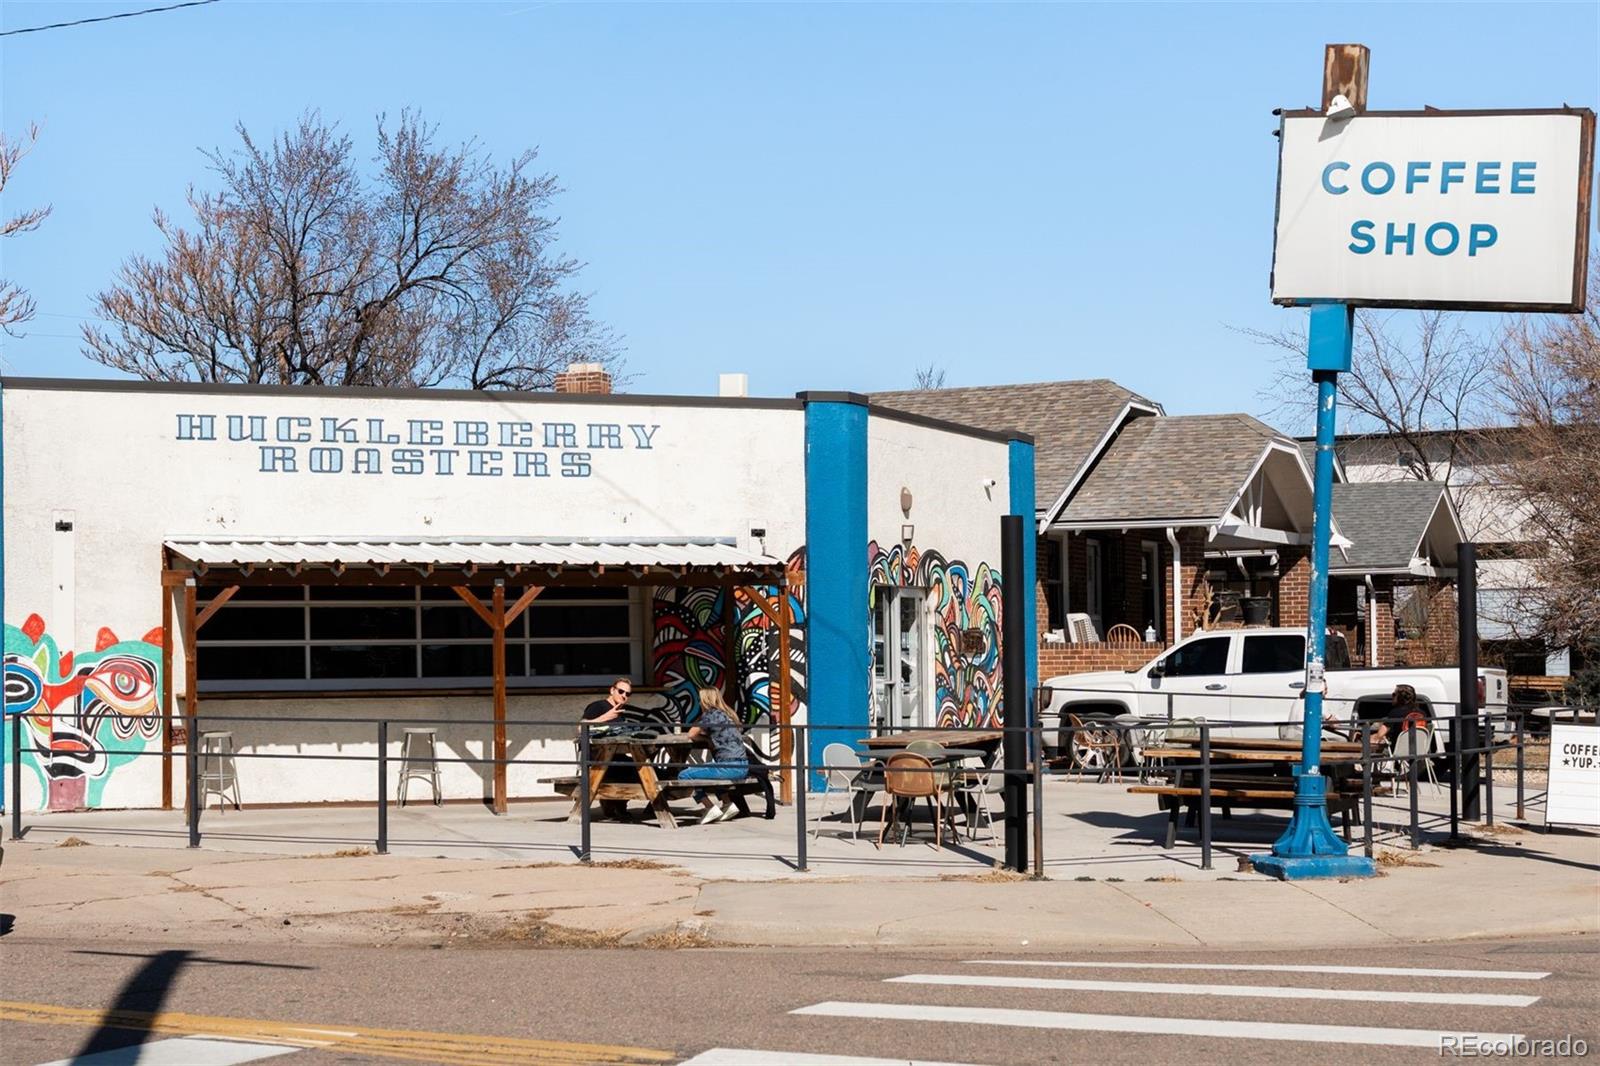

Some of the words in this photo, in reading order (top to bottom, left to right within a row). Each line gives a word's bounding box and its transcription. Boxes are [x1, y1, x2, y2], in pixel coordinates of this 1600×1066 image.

[1321, 161, 1537, 195] COFFEE
[1348, 219, 1498, 257] SHOP
[175, 414, 661, 450] HUCKLEBERRY
[259, 446, 592, 478] ROASTERS
[1563, 743, 1600, 756] COFFE
